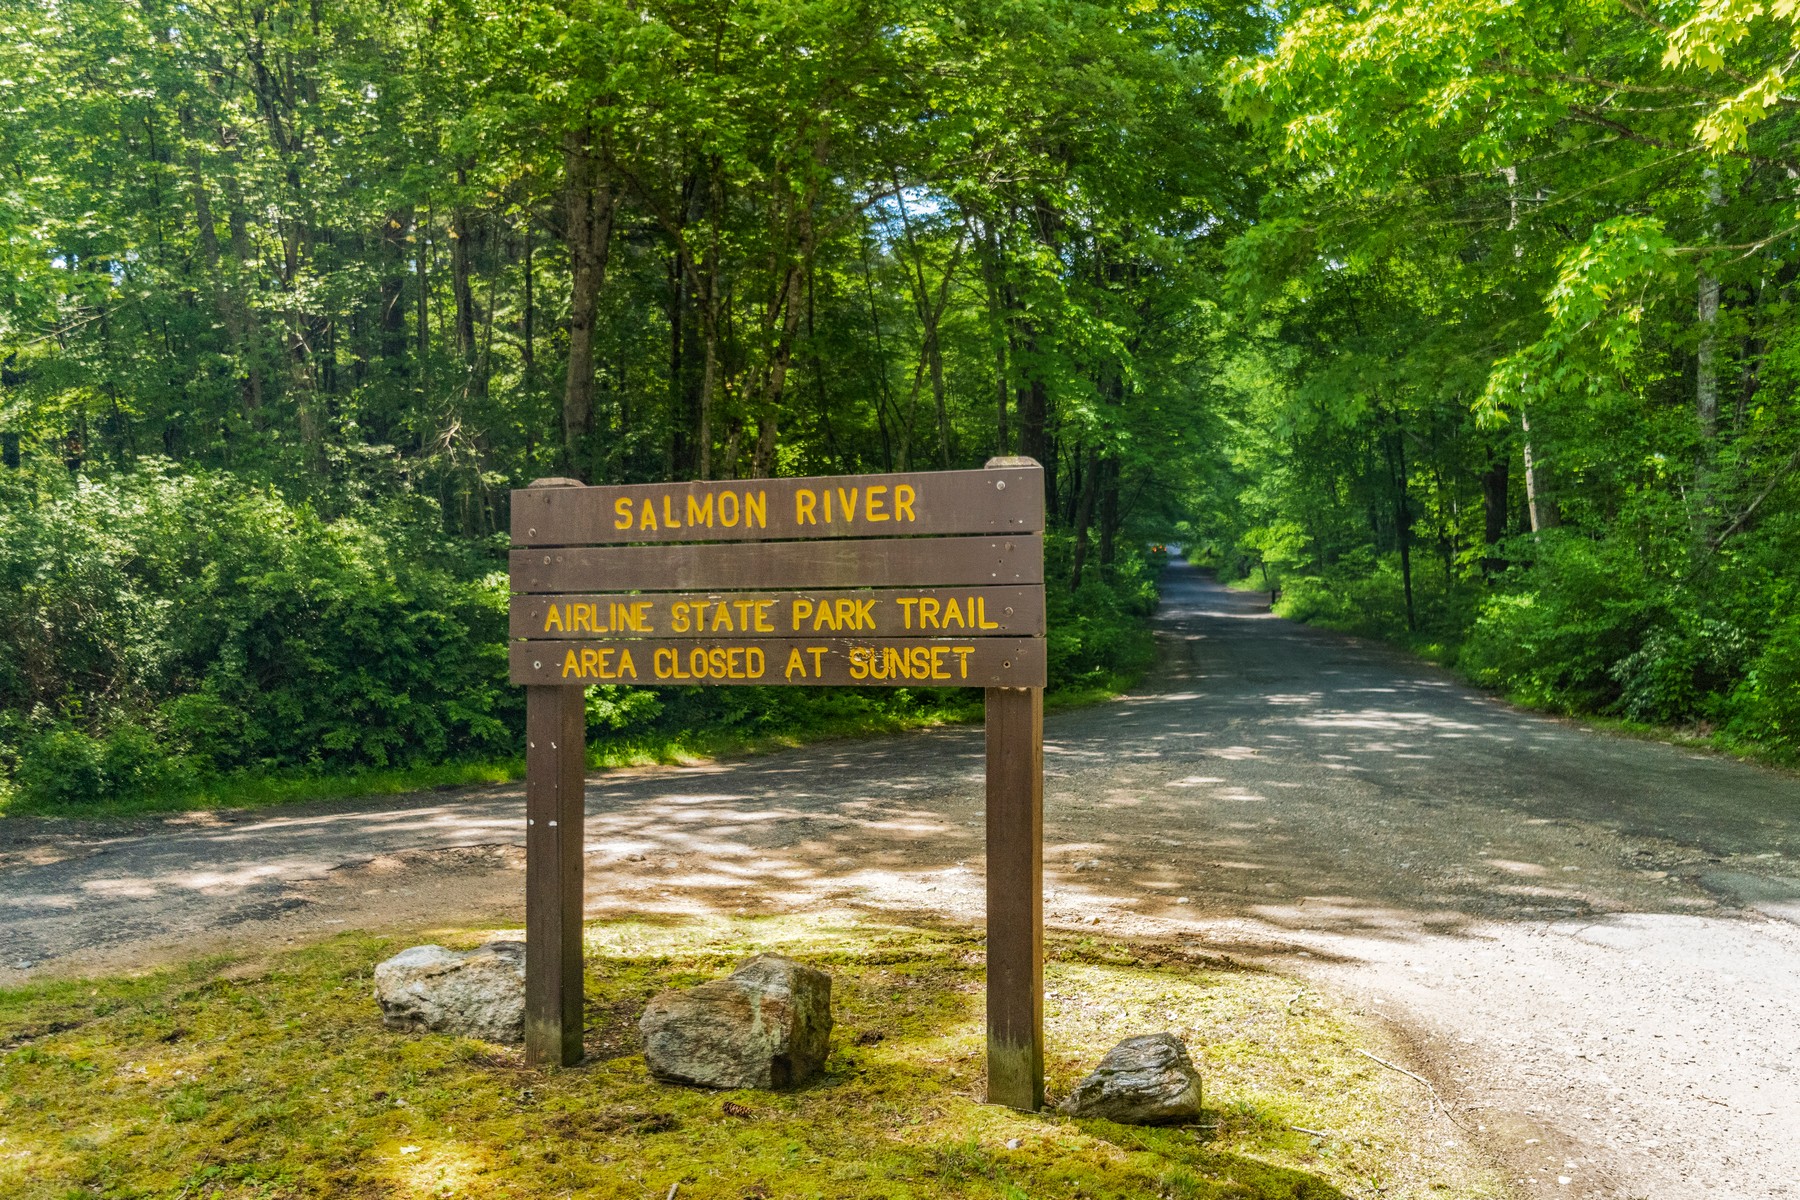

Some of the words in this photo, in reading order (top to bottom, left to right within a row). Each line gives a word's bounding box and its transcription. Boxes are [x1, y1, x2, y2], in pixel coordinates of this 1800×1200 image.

[613, 488, 768, 531] SALMON
[794, 483, 917, 526] RIVER
[543, 600, 655, 634] AIRLINE
[670, 598, 776, 634] STATE
[790, 596, 878, 633] PARK
[894, 595, 1000, 631] TRAIL
[560, 646, 638, 681] AREA
[652, 645, 766, 681] CLOSED
[783, 646, 829, 684] AT
[848, 644, 976, 682] SUNSET
